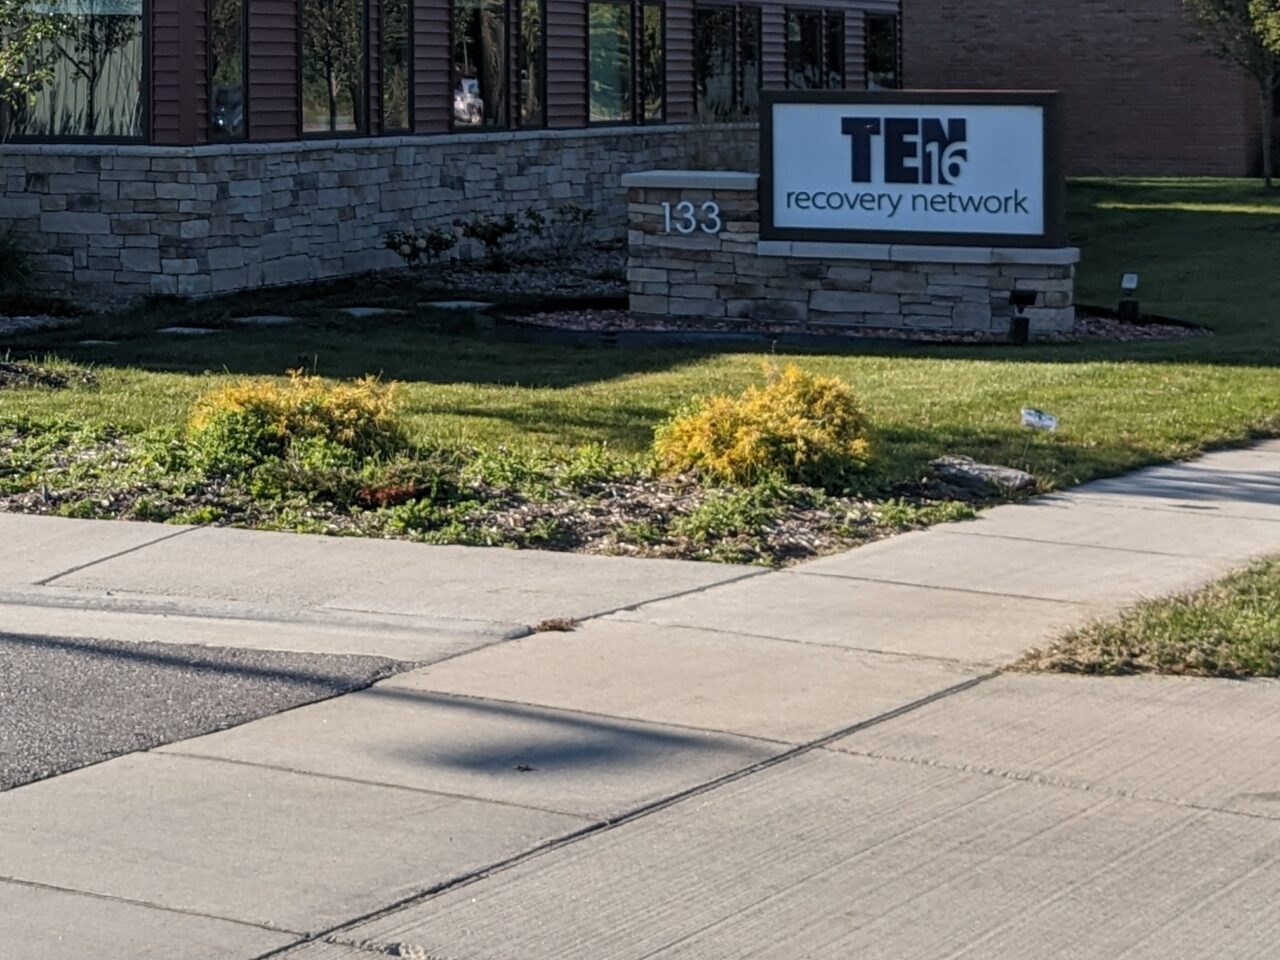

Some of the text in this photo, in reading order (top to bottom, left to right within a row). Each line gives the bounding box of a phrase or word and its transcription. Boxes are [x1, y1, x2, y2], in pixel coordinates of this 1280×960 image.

[841, 117, 967, 184] TEN
[925, 141, 968, 185] 16
[661, 201, 721, 234] 133
[786, 188, 1029, 217] recovery network
